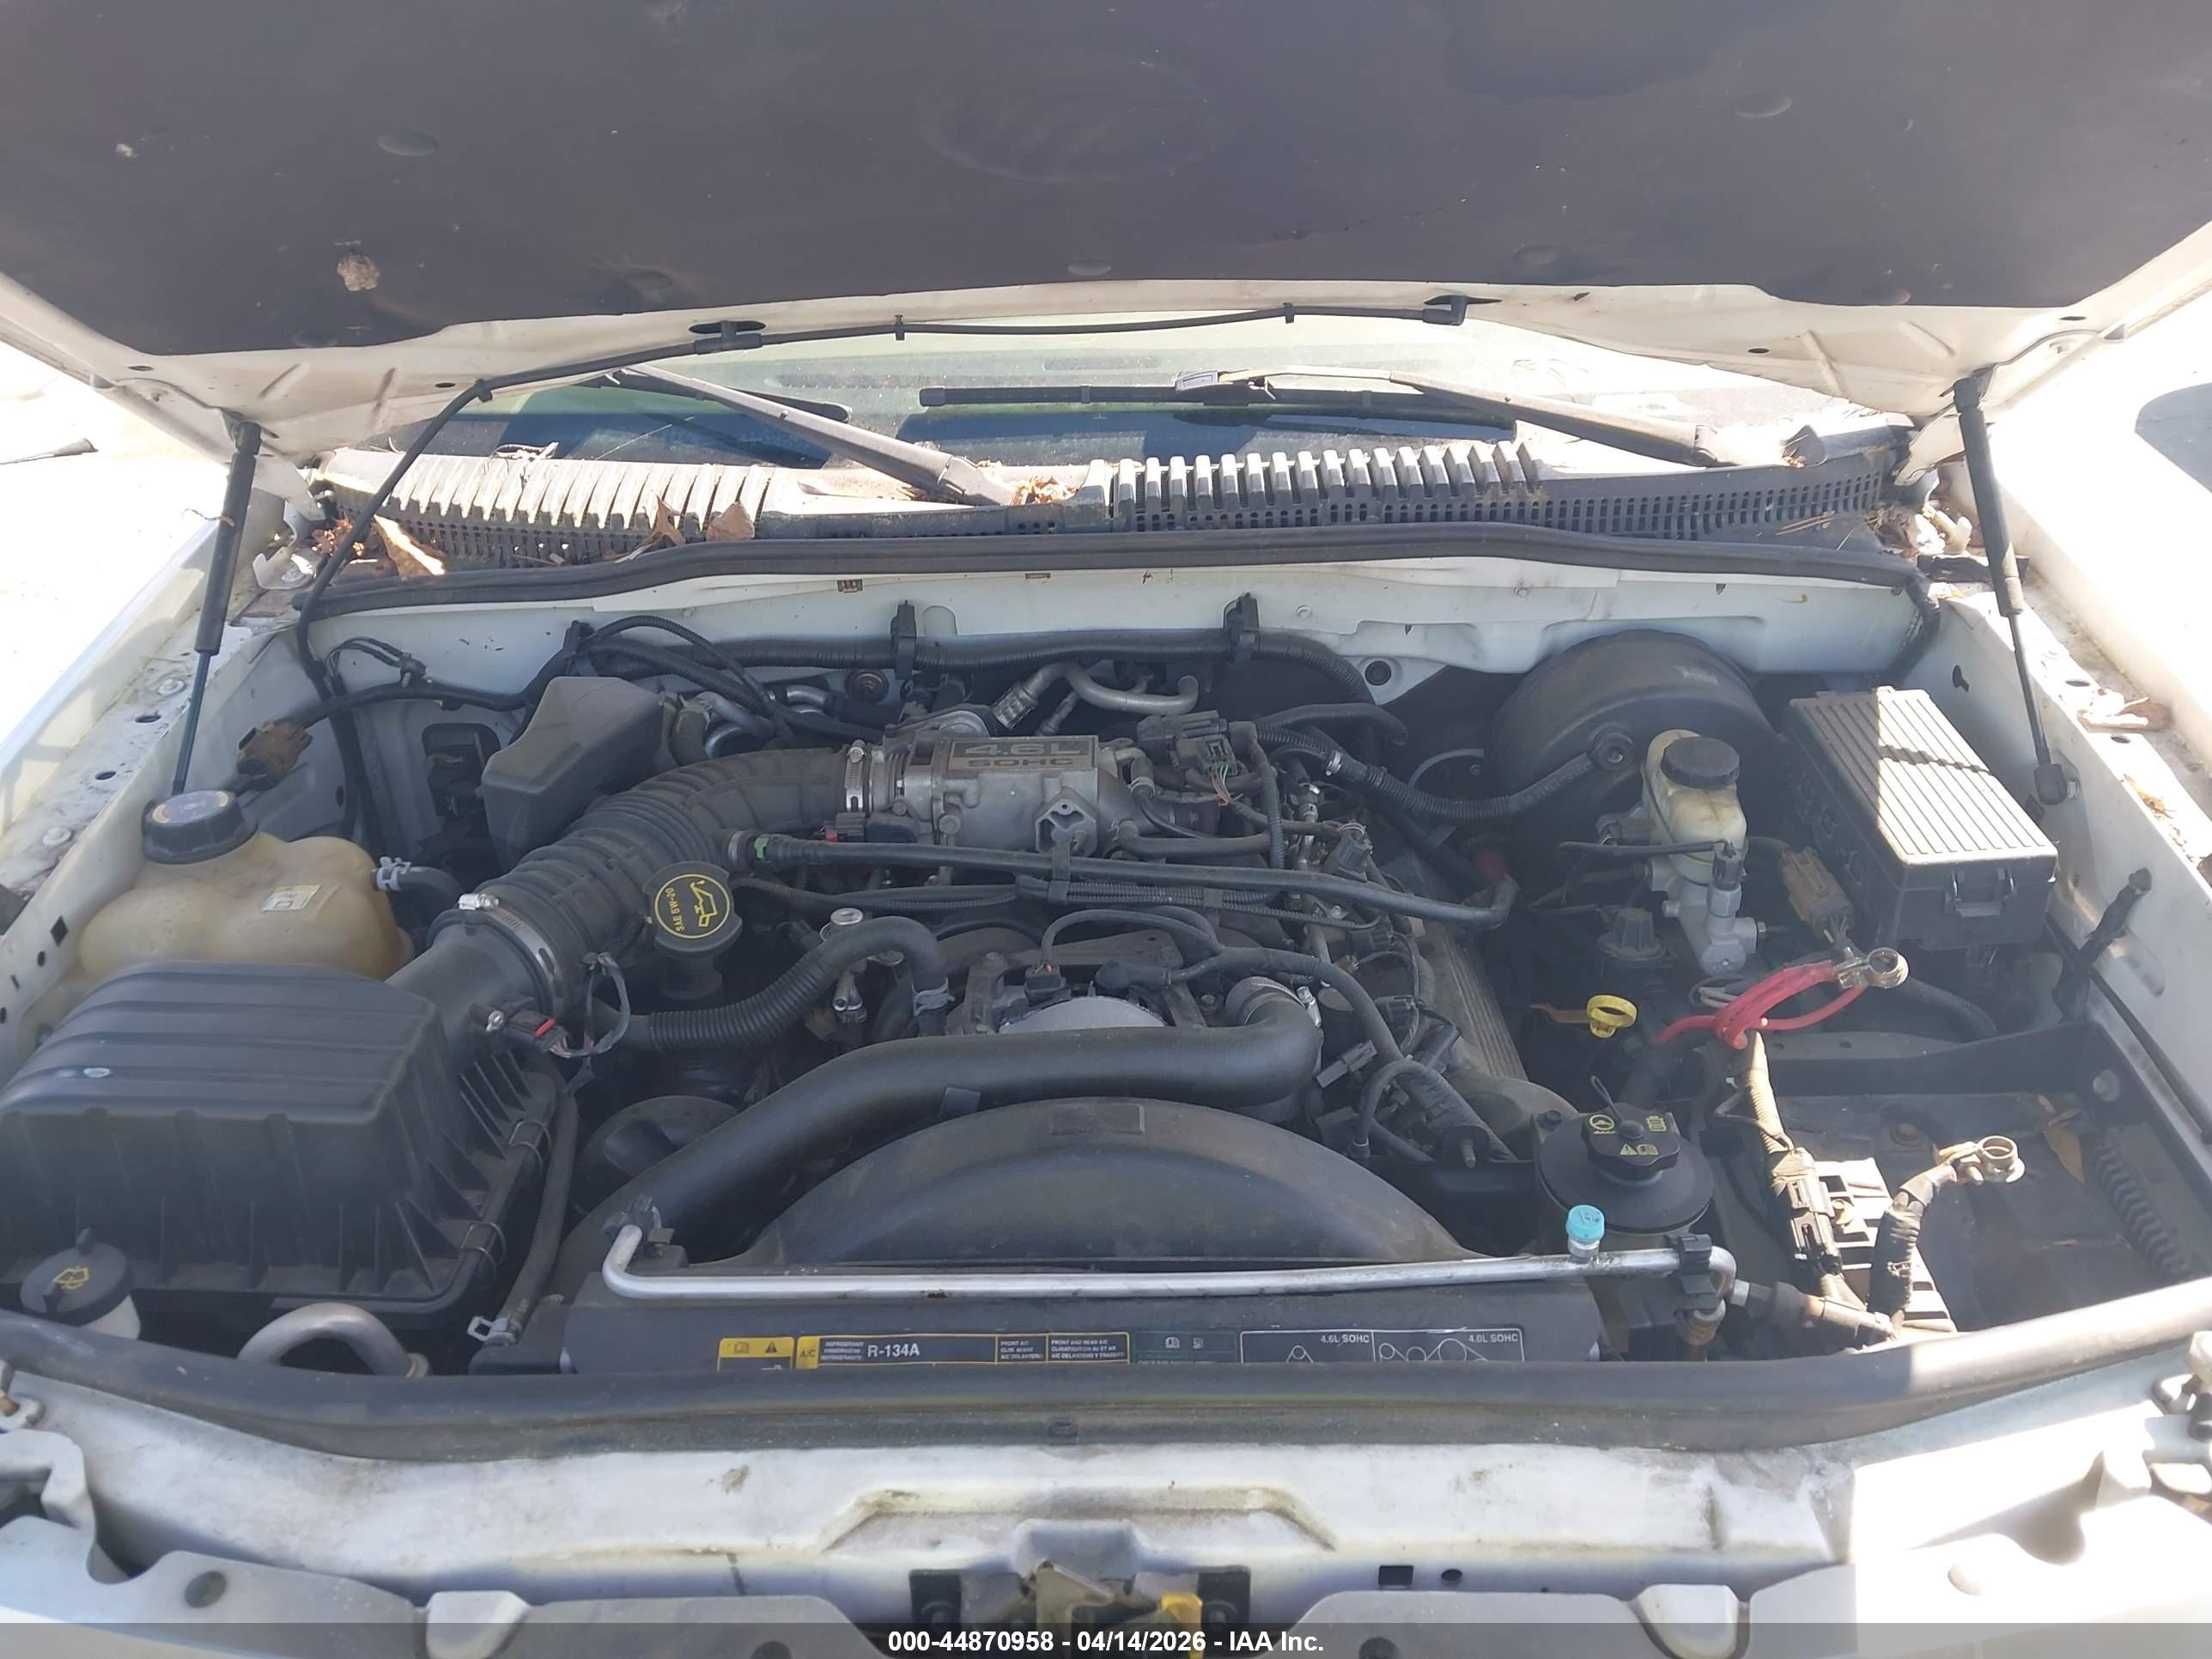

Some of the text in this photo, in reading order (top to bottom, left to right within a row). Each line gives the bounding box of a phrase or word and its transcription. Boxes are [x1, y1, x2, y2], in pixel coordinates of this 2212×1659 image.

[964, 743, 1080, 757] 4.6L
[968, 757, 1074, 767] SOHC
[672, 915, 685, 933] SAE
[1321, 1334, 1370, 1344] 4.6L SOHC
[1490, 1334, 1518, 1342] SOHC
[799, 1349, 817, 1358] A/C
[867, 1343, 921, 1358] R-134A
